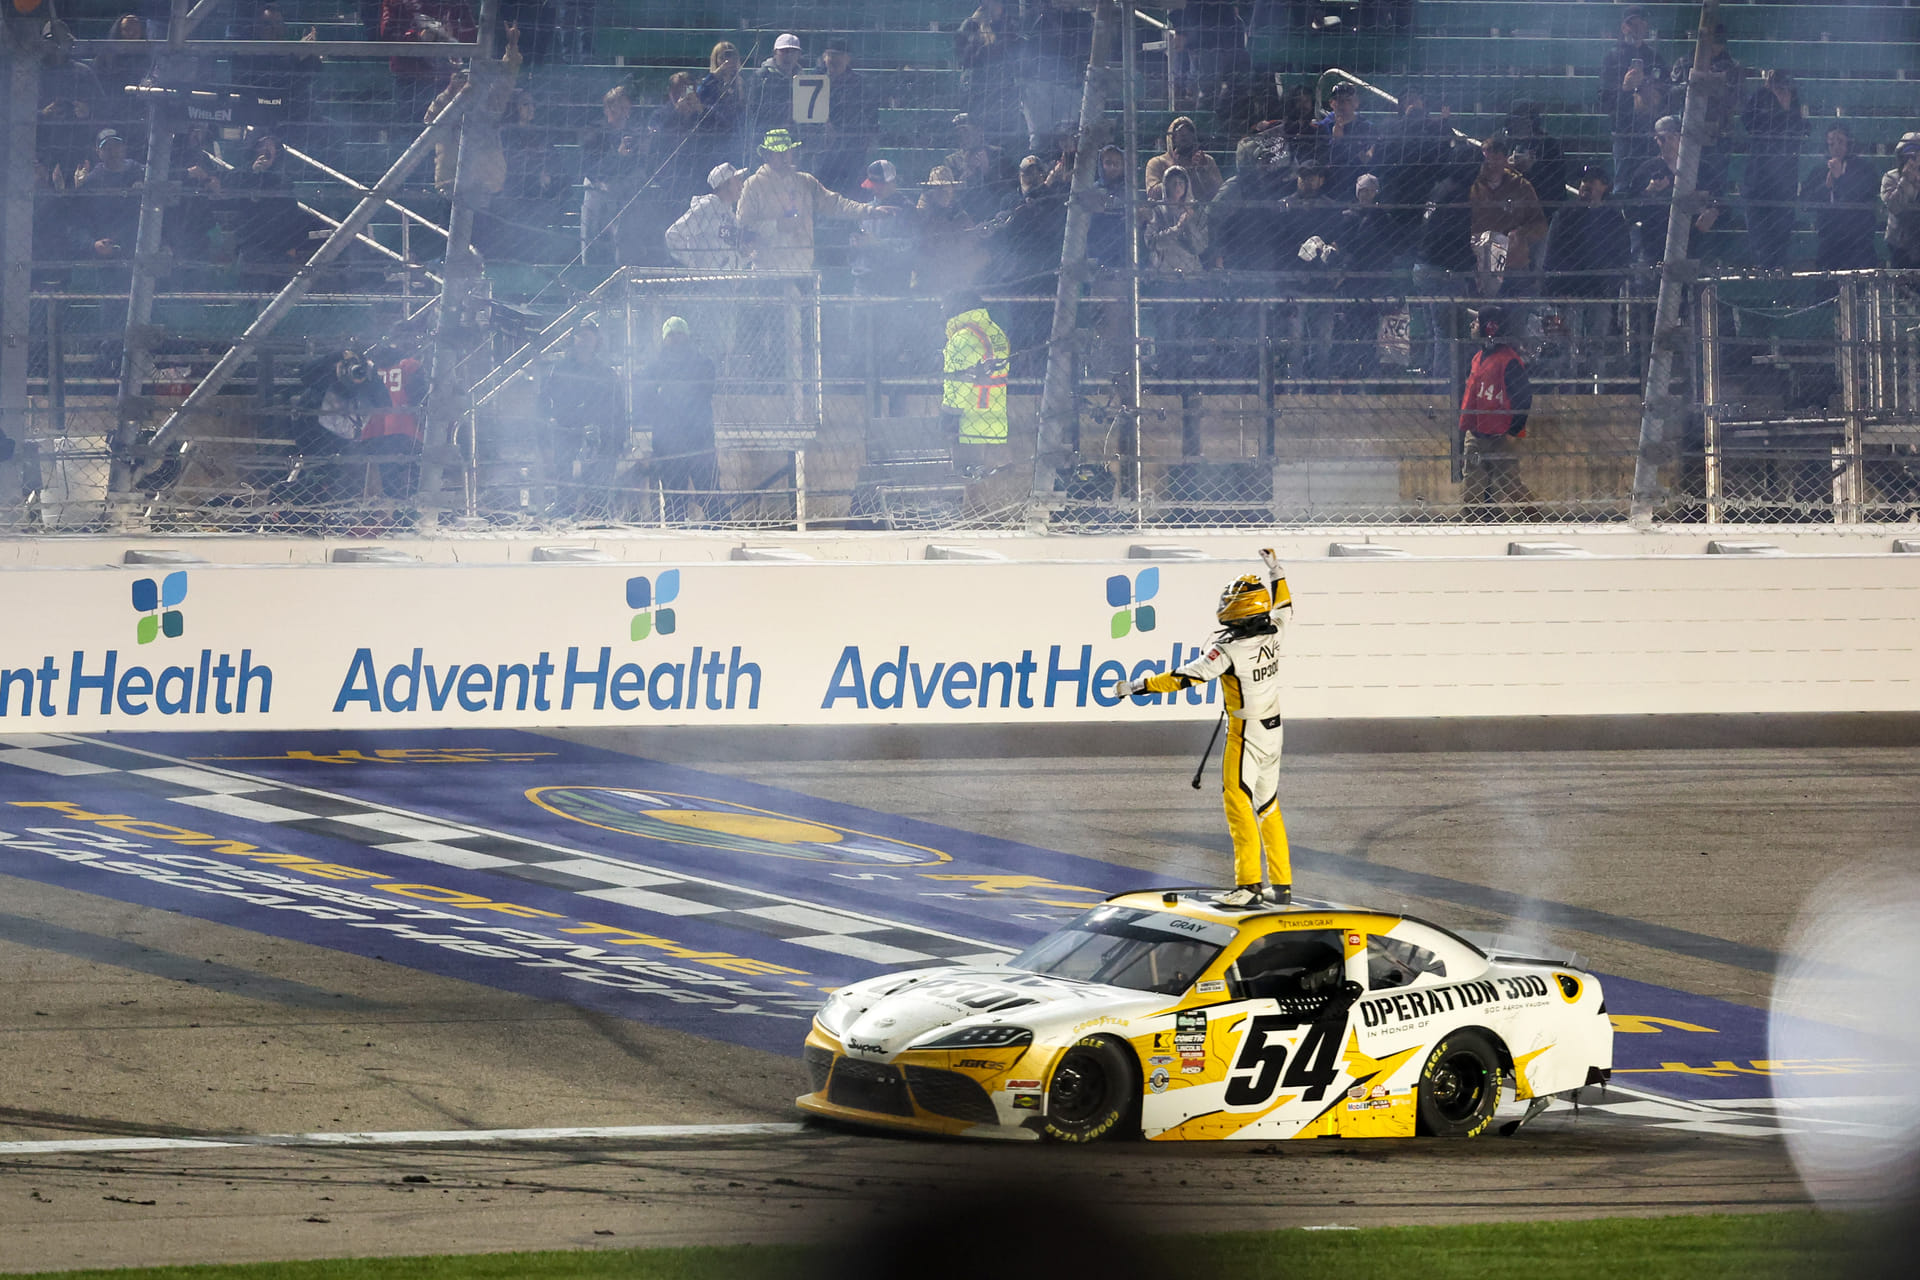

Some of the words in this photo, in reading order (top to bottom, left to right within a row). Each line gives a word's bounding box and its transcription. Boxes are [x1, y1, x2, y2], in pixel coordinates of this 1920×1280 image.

[188, 106, 232, 121] WHELEN
[798, 79, 824, 119] 7
[332, 646, 762, 713] AdventHealth
[7, 801, 395, 880] HOME
[371, 884, 568, 918] OF
[25, 827, 487, 925] CLOSEST
[451, 926, 800, 997] FINISH
[1169, 919, 1207, 933] GRAY
[1314, 919, 1333, 927] GRAY
[348, 922, 809, 1020] HISTORY
[1360, 980, 1500, 1027] OPERATION
[1498, 975, 1548, 1000] 300
[1073, 1016, 1130, 1033] GOODYEAR
[1381, 1024, 1414, 1035] HONOR
[848, 1038, 888, 1056] Supra
[1224, 1011, 1349, 1106] 54
[1424, 1042, 1449, 1078] EAGLE
